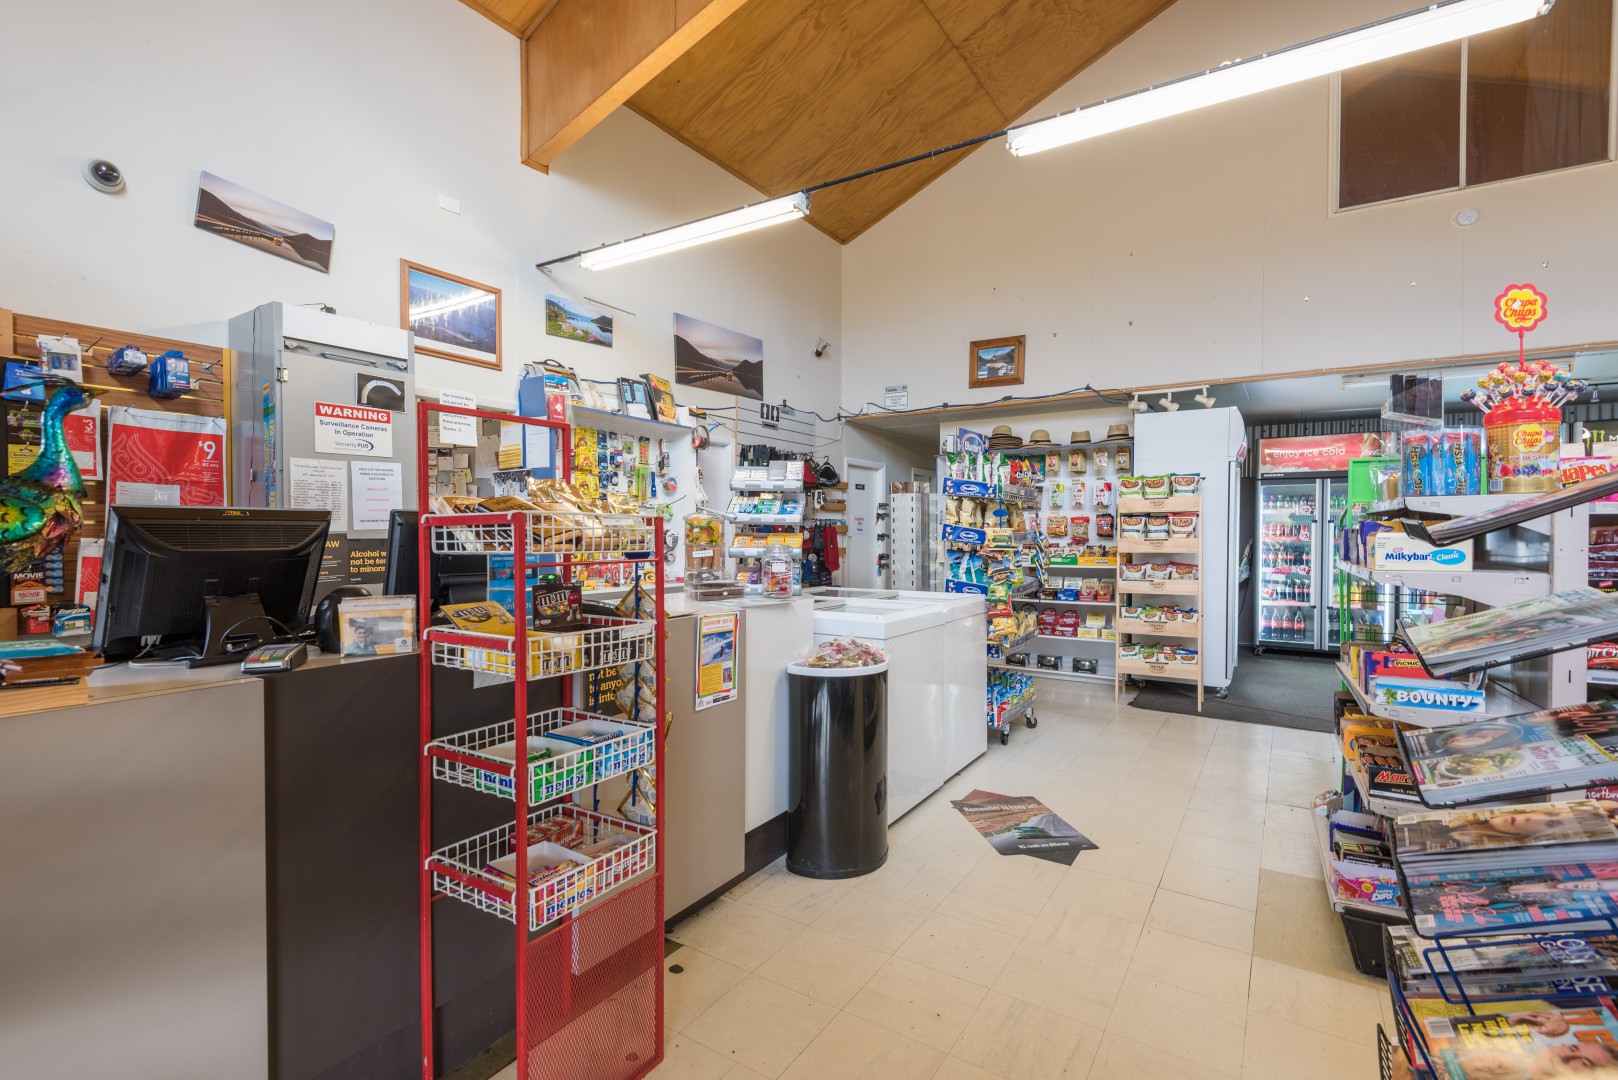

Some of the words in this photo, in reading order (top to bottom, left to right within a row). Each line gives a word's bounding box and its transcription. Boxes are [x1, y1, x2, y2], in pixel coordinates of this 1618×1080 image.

[1505, 297, 1538, 308] Chupa
[1503, 308, 1537, 323] Chups
[319, 405, 388, 421] WARNING
[319, 419, 360, 429] Surveillance
[361, 423, 388, 432] Cameras
[343, 429, 374, 438] Operation
[1516, 429, 1543, 440] Chupa
[335, 440, 357, 449] Security
[1515, 436, 1542, 448] Chups
[1273, 449, 1301, 459] enjoy
[1304, 448, 1319, 457] ice
[1322, 446, 1346, 456] cold
[1411, 446, 1420, 468] FISH
[1413, 477, 1423, 495] BIG
[325, 540, 340, 548] AW
[350, 550, 379, 558] Alcohol
[1385, 551, 1431, 562] Milkybar
[1436, 550, 1460, 561] Classic
[350, 558, 363, 566] not
[364, 557, 375, 565] be
[360, 565, 386, 573] minors
[13, 572, 44, 580] MOVIE
[58, 607, 89, 615] Energizer
[589, 671, 604, 682] nt
[605, 667, 617, 678] be
[600, 679, 624, 691] anyo
[1396, 690, 1474, 708] BOUNTY
[609, 751, 647, 772] mentos
[479, 771, 513, 790] ment
[541, 772, 588, 798] mentos
[963, 805, 1000, 813] Remember
[1009, 803, 1025, 811] keep
[546, 886, 594, 916] mentos
[1370, 892, 1394, 902] DIPS
